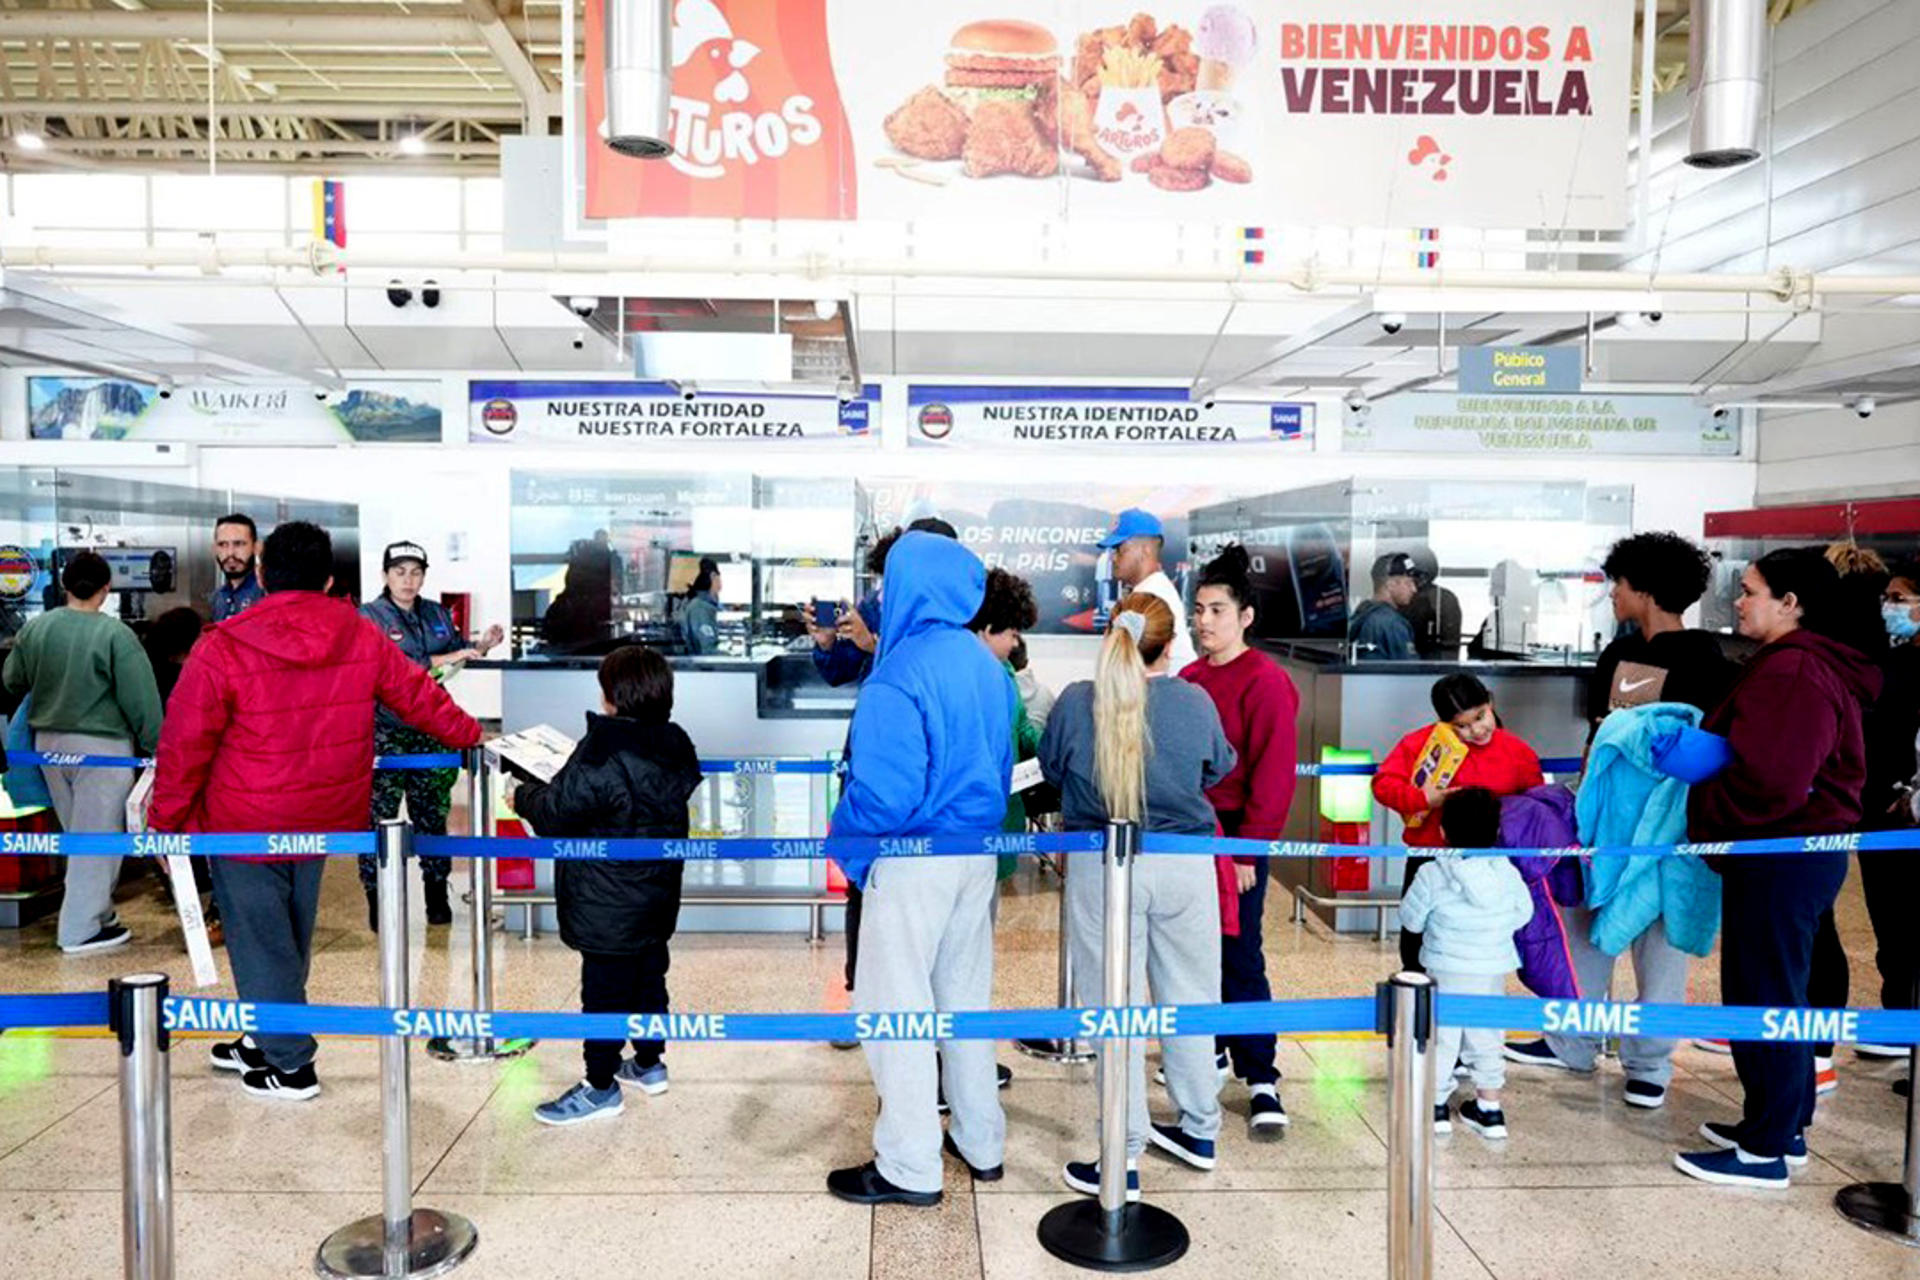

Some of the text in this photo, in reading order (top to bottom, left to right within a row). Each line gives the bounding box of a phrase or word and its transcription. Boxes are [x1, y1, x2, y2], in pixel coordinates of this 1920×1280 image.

[1281, 24, 1592, 61] BIENVENIDOS A
[1281, 68, 1592, 116] VENEZUELA
[598, 95, 822, 167] TUROS
[1493, 370, 1546, 386] General
[547, 402, 764, 418] NUESTRA IDENTIDAD
[983, 407, 1199, 423] NUESTRA IDENTIDAD
[578, 421, 804, 437] NUESTRA FORTALEZA
[1014, 425, 1237, 442] NUESTRA FORTALEZA
[999, 526, 1107, 545] RINCONES
[1016, 548, 1070, 571] PAÍS
[734, 761, 777, 774] SAIME
[1295, 764, 1320, 775] IME
[2, 833, 327, 854] SAIME SAIME SAIME
[553, 836, 1036, 858] SAIME SAIME SAIME SAIME SAIME
[1267, 841, 1329, 857] SAIME
[1673, 841, 1734, 856] SAIME
[1803, 833, 1861, 852] SAIME
[163, 999, 1178, 1039] SAIME SAIME SAIME SAIME SAIME
[1543, 1001, 1860, 1041] SAIME SAIME
